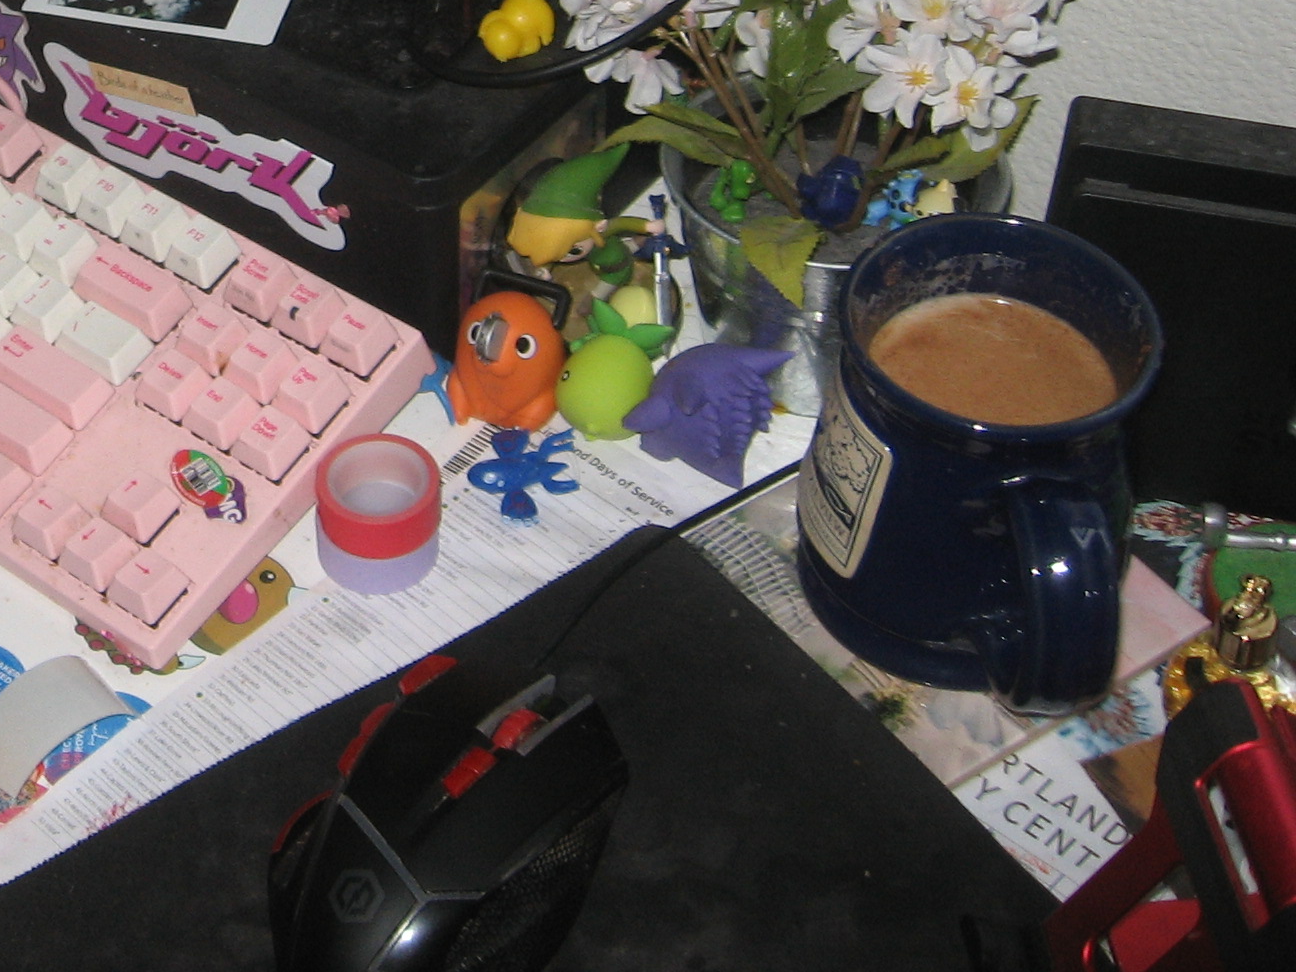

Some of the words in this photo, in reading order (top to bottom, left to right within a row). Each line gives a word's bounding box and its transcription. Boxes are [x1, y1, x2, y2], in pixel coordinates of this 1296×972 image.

[98, 180, 114, 192] F10
[142, 204, 160, 216] F11
[186, 228, 204, 242] F12
[252, 258, 269, 273] Print
[110, 264, 152, 292] Backspace
[243, 266, 269, 282] Screen
[289, 290, 310, 305] Lock
[296, 283, 320, 300] Scroll
[196, 316, 219, 329] Insert
[344, 314, 366, 330] Pause
[10, 334, 34, 351] Enter
[246, 342, 268, 359] Home
[158, 361, 184, 380] Delete
[299, 366, 318, 382] Page
[206, 389, 223, 403] End
[251, 423, 277, 440] Down
[260, 416, 278, 432] Page
[589, 456, 618, 481] Days
[618, 478, 634, 489] of
[630, 486, 675, 518] Service
